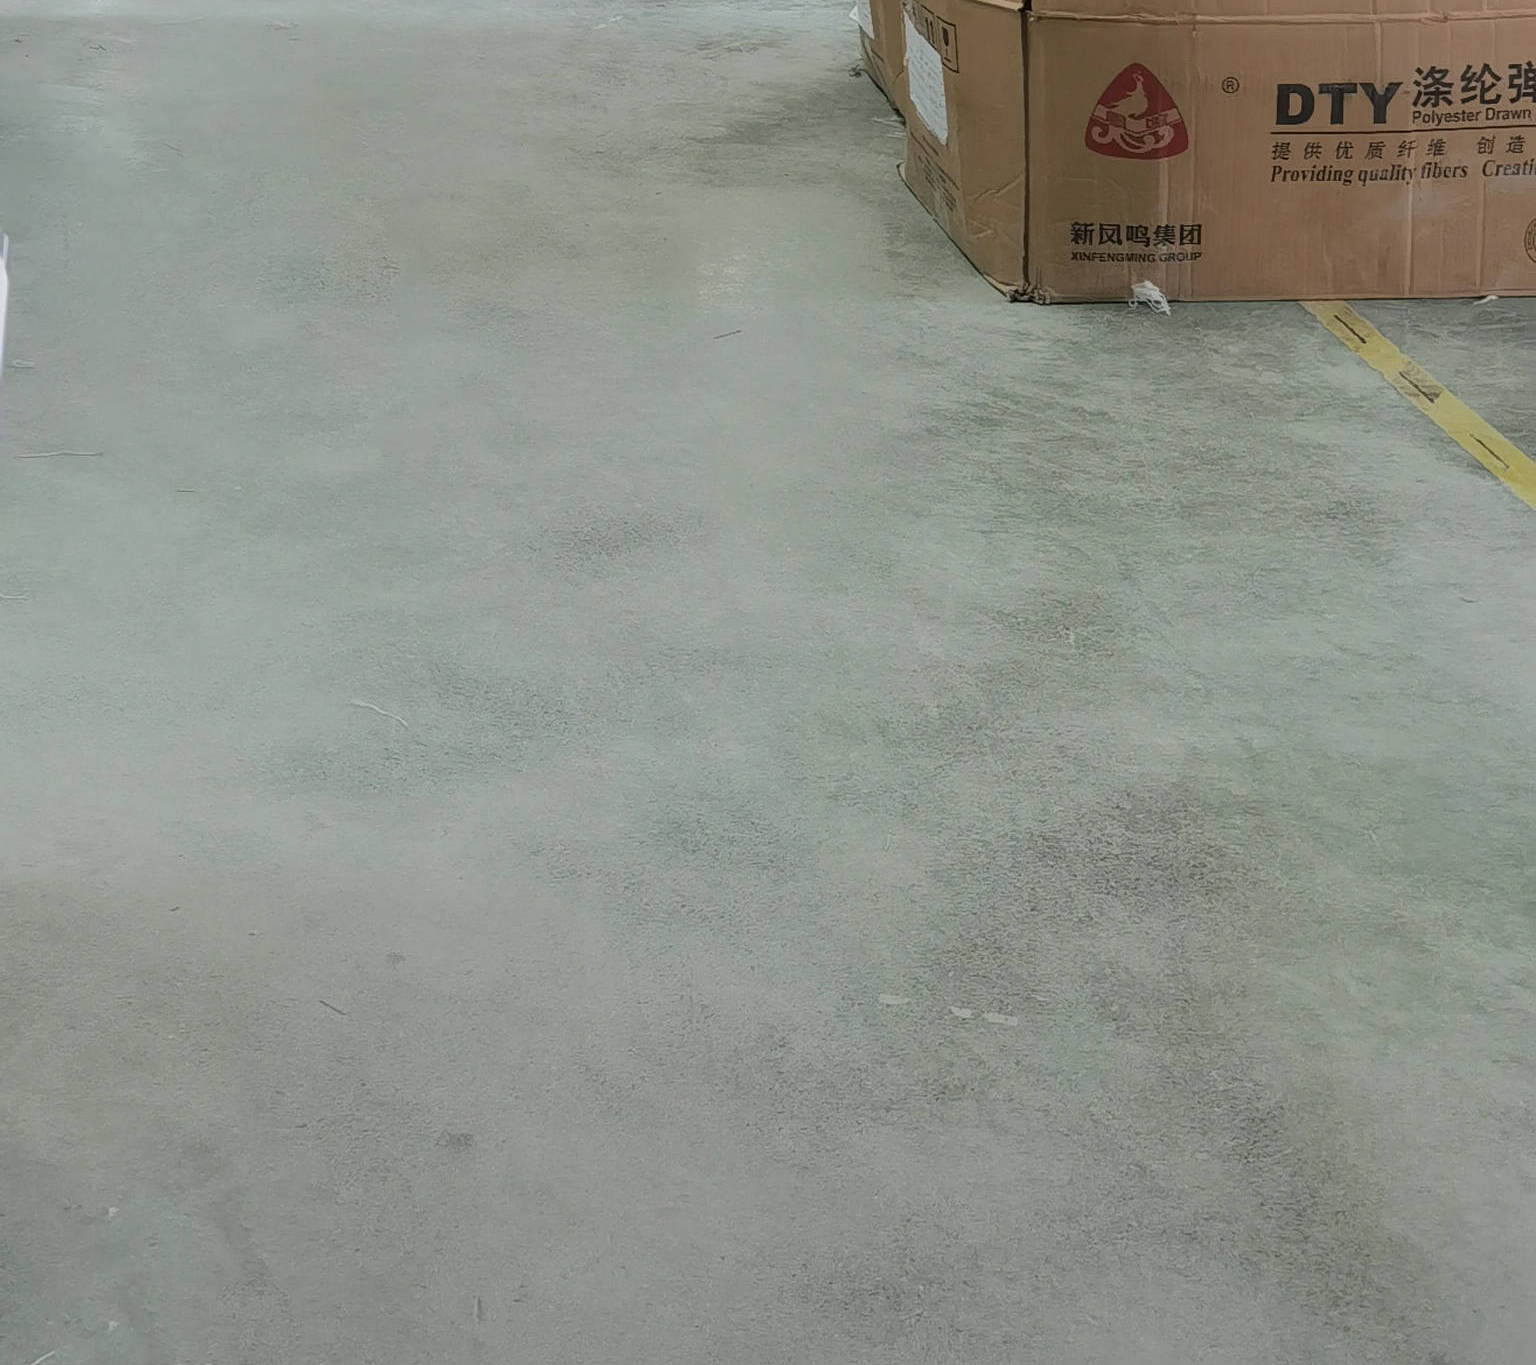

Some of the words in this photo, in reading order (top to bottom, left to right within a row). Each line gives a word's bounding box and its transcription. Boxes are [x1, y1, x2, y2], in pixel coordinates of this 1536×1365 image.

[1275, 80, 1403, 126] DTY
[1412, 109, 1482, 127] Polyester
[1485, 107, 1532, 121] Drawn
[1270, 137, 1448, 161] 提供优质纤维
[1476, 134, 1526, 155] 创造
[1270, 164, 1353, 186] Providing
[1357, 163, 1417, 186] quality
[1420, 161, 1469, 180] fibers
[1482, 158, 1536, 178] Creati
[1070, 220, 1203, 248] 新凤鸣集团
[1070, 251, 1156, 263] XINFENGMING
[1159, 251, 1203, 262] GROUP
